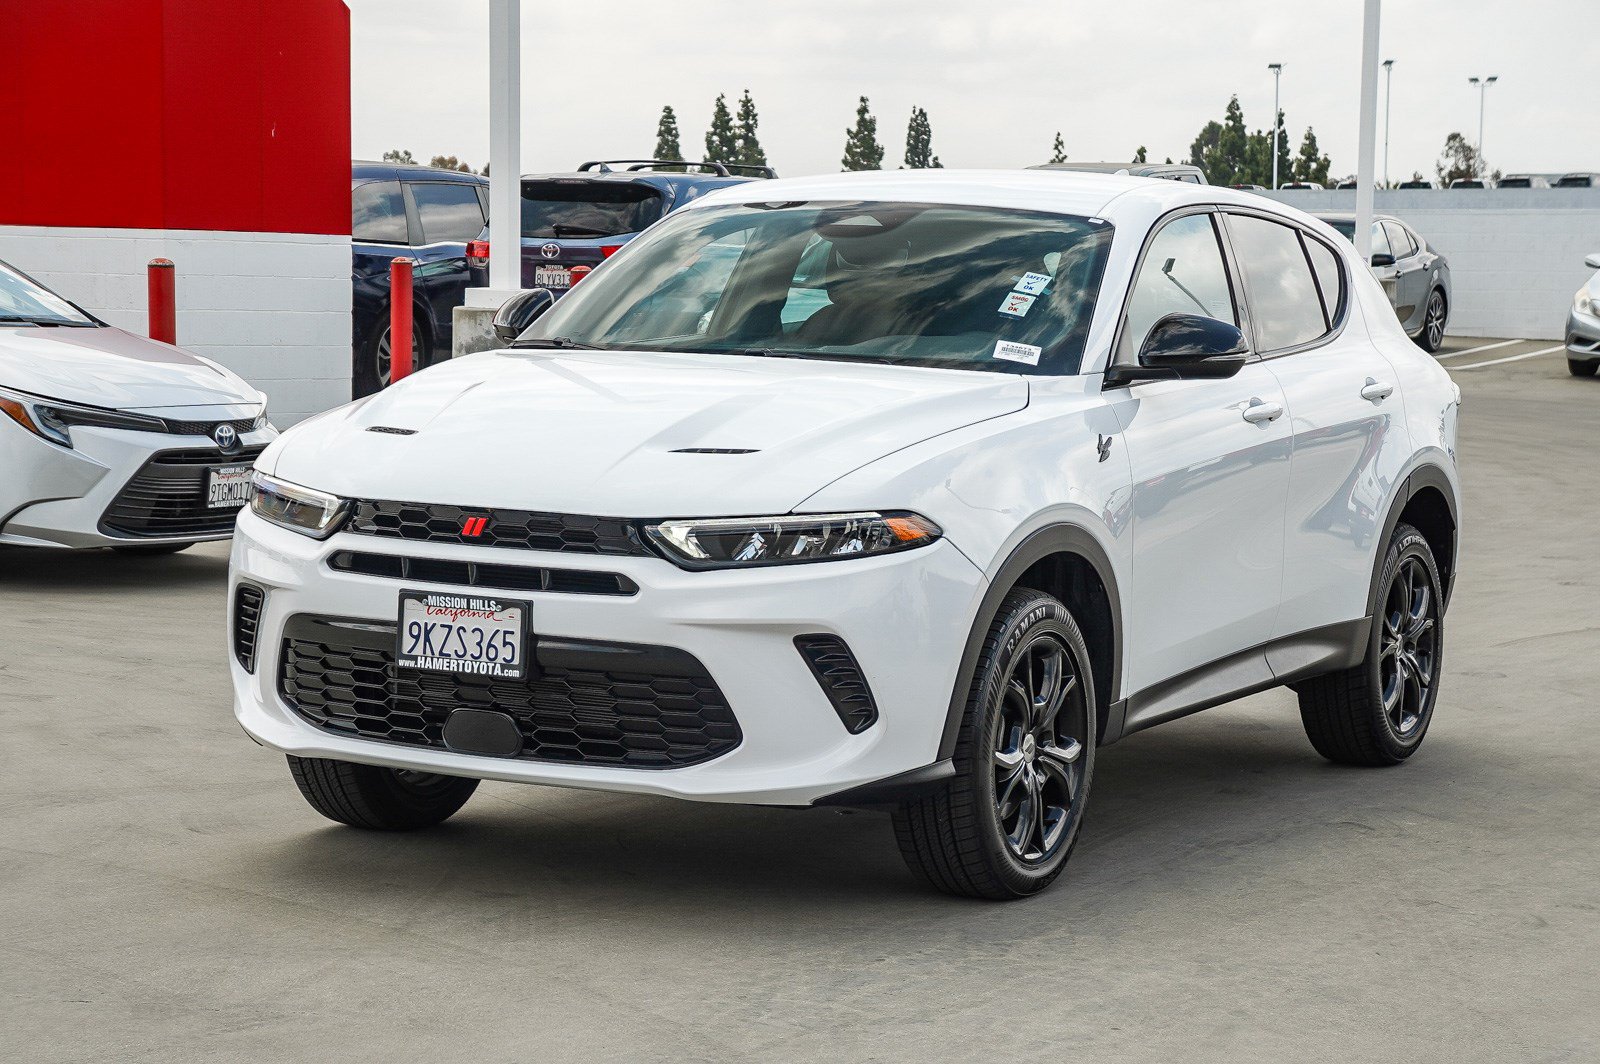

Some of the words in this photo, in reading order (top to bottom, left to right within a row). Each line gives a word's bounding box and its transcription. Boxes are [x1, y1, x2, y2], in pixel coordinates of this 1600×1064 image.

[1025, 274, 1048, 282] SAFETY
[210, 481, 250, 502] 9TGM017
[427, 595, 468, 609] MISSION
[469, 599, 497, 612] HILLS
[1006, 606, 1047, 656] RAMANI
[407, 621, 516, 663] 9KZS365
[398, 656, 520, 678] www.HAMERTOYOTA.com
